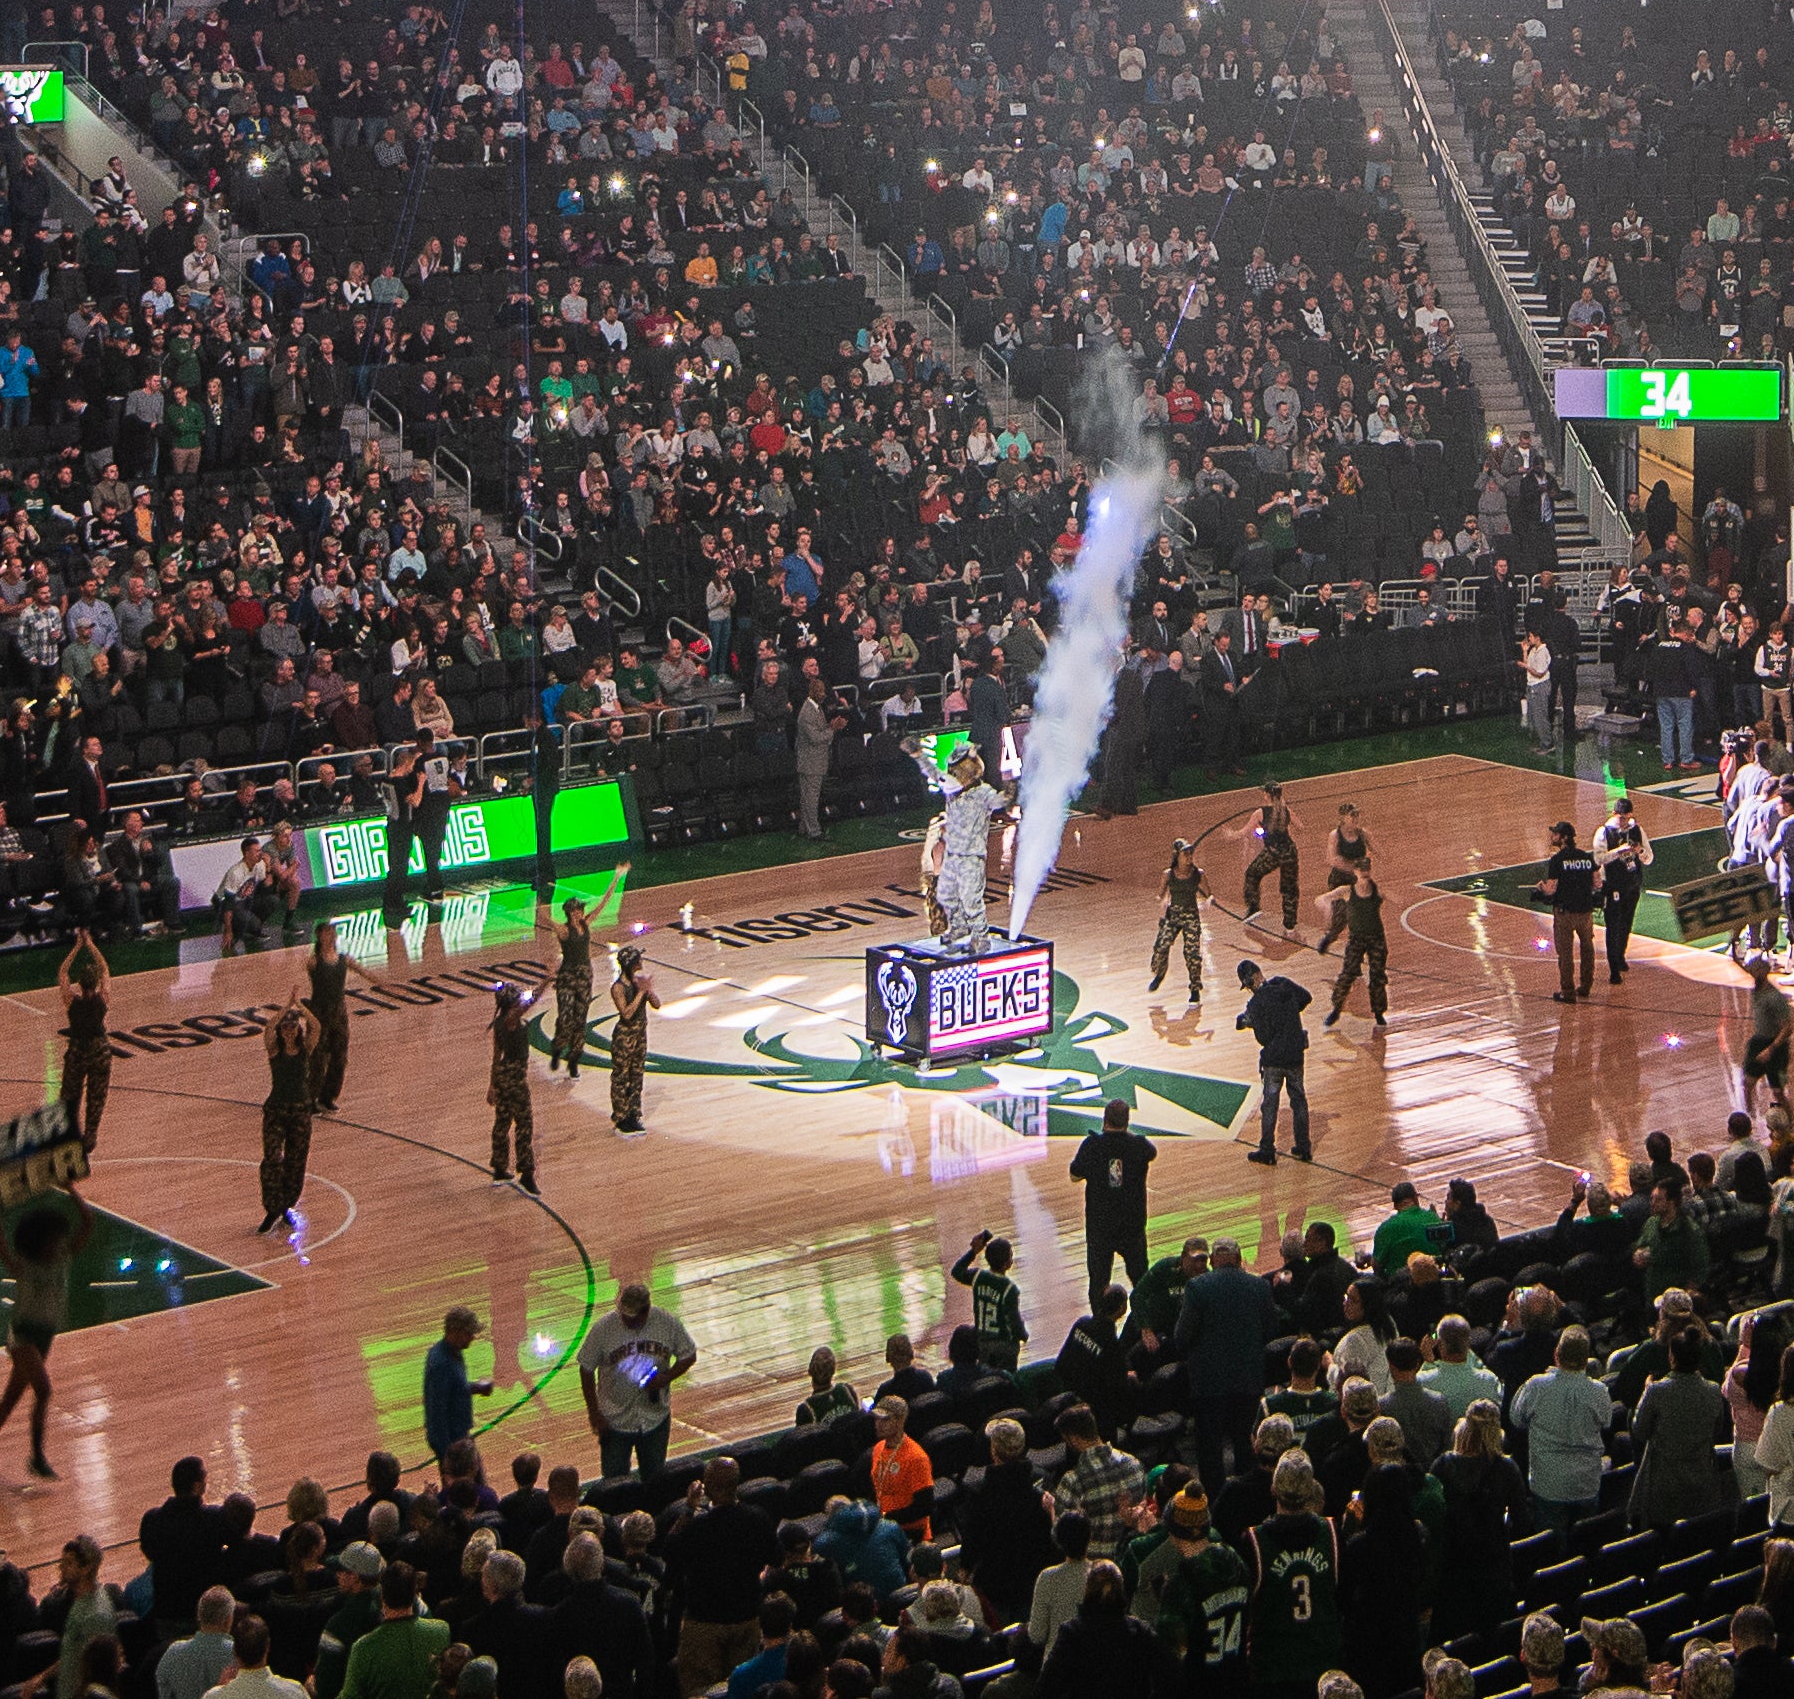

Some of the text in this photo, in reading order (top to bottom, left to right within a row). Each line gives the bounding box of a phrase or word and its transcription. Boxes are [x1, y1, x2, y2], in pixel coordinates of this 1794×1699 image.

[1640, 371, 1693, 418] 34
[1563, 859, 1593, 871] PHOTO
[939, 968, 1041, 1033] BUCKS
[978, 1301, 1001, 1333] 12
[1269, 1546, 1330, 1578] JENNINGS
[1292, 1574, 1312, 1621] 3
[1205, 1610, 1243, 1664] 34
